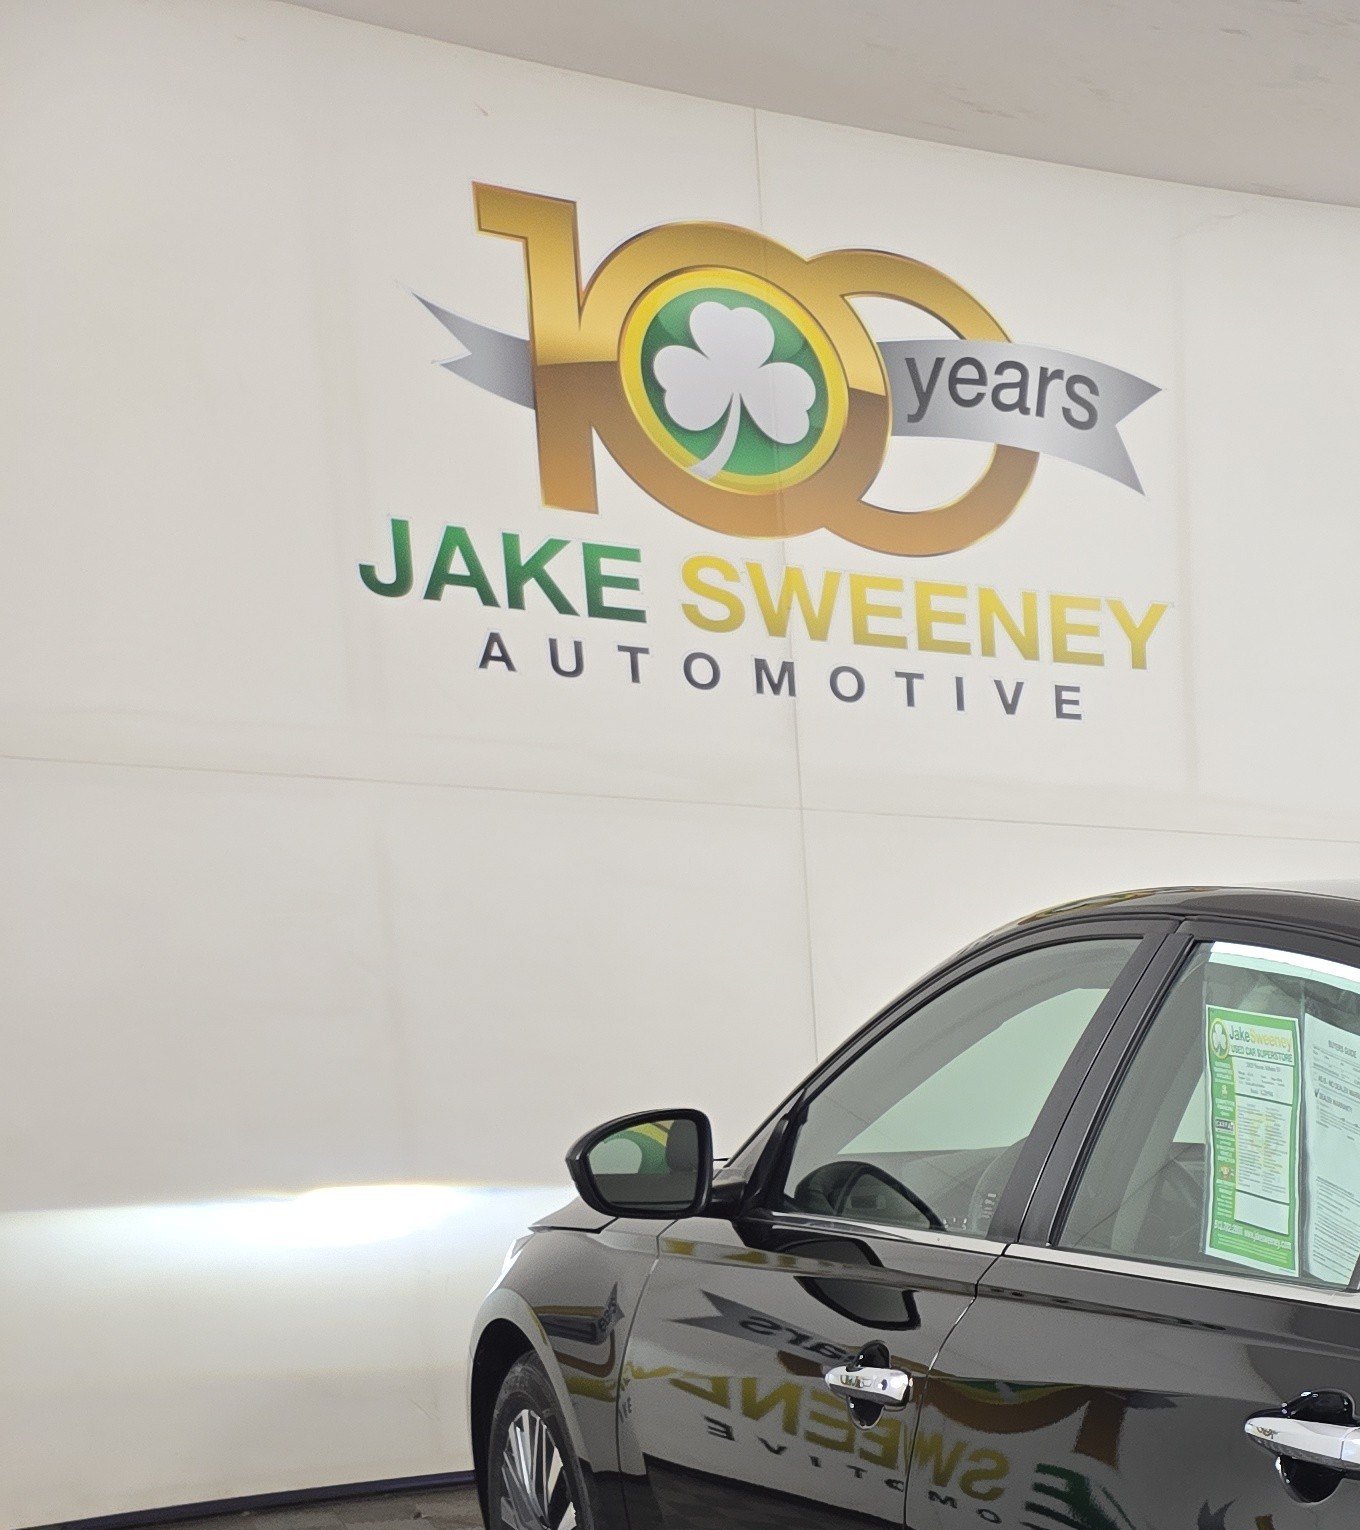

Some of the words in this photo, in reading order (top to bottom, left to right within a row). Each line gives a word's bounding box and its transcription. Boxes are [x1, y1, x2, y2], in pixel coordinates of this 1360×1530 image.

[905, 354, 1102, 431] years
[358, 517, 647, 624] JAKE
[681, 555, 1169, 671] SWEENEY
[478, 632, 1084, 722] AUTOMOTIVE
